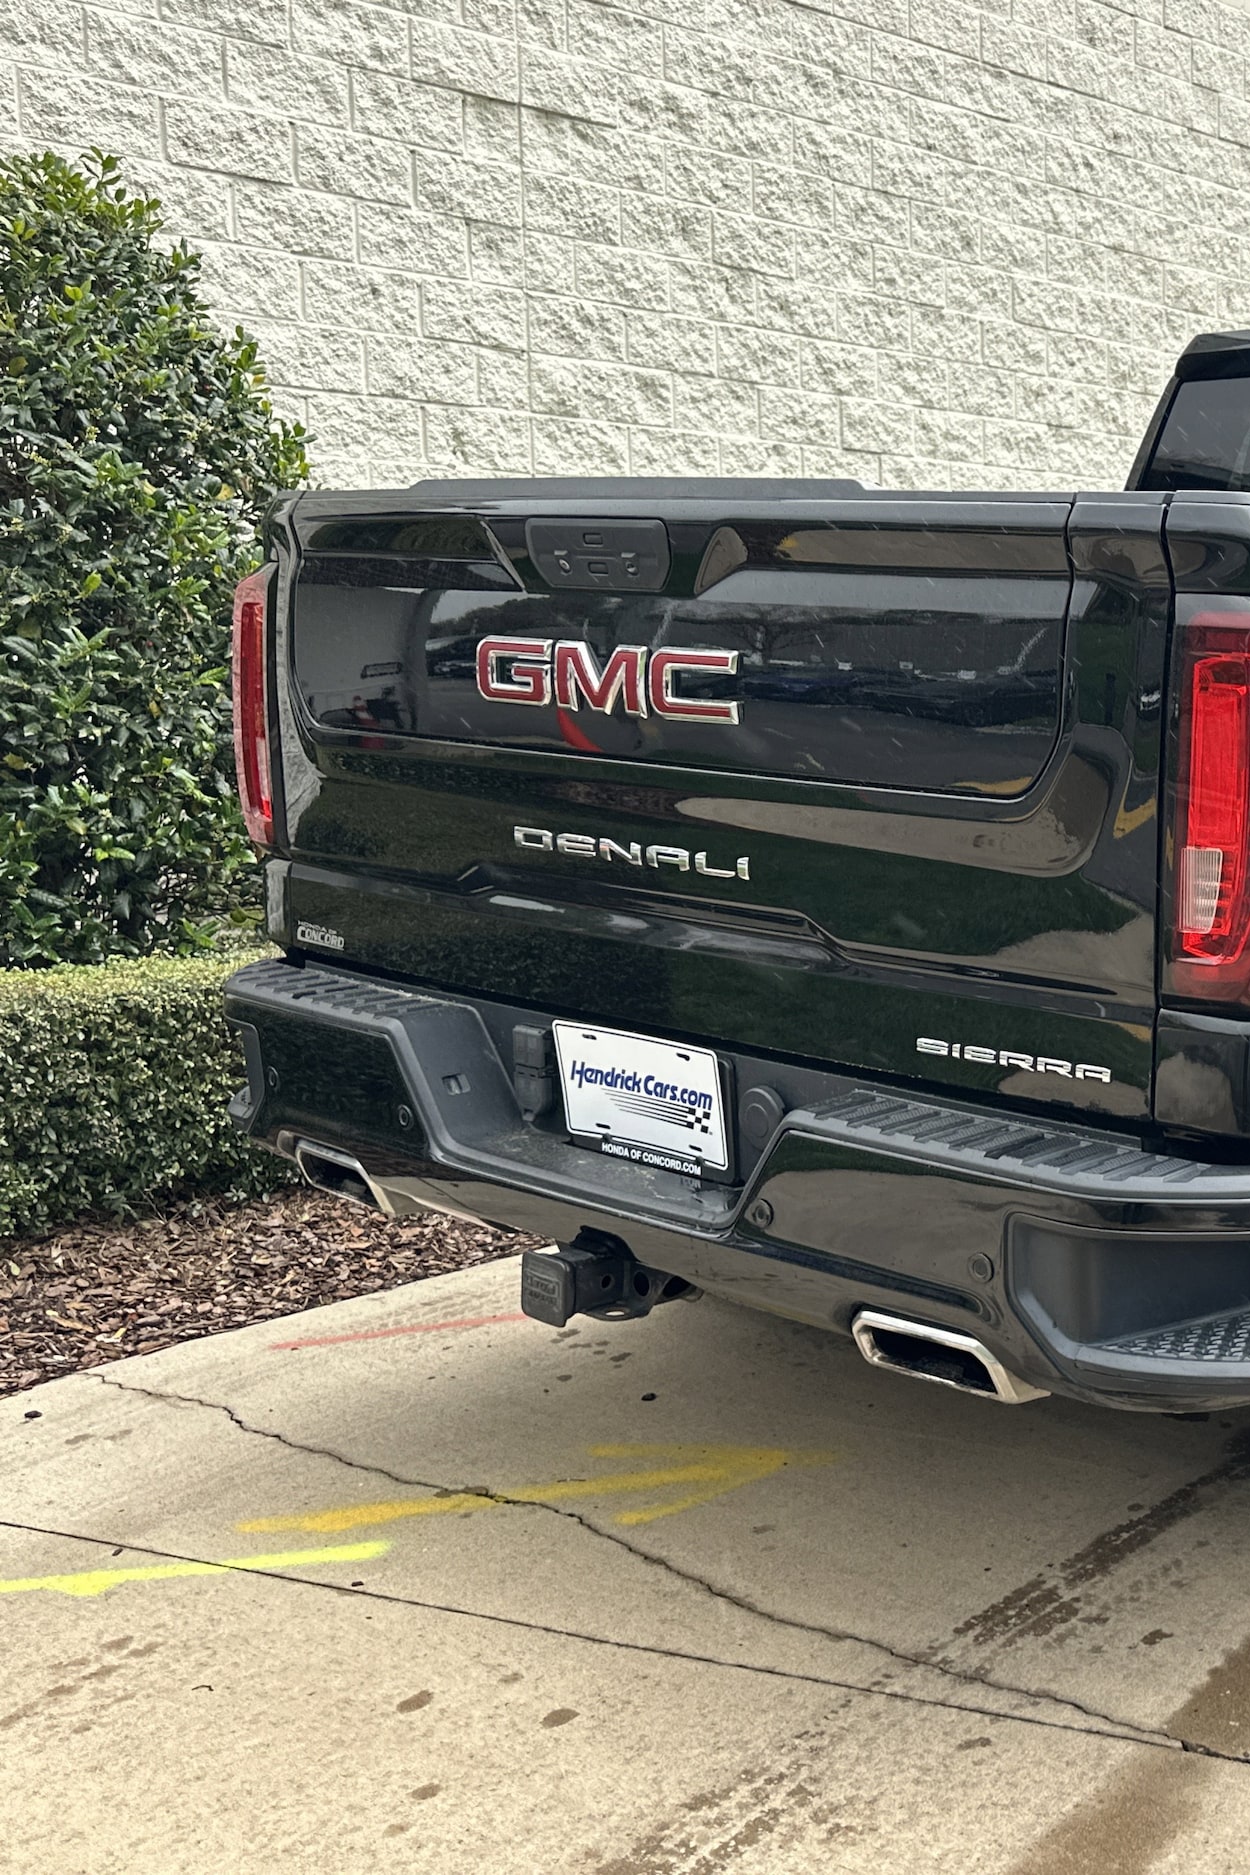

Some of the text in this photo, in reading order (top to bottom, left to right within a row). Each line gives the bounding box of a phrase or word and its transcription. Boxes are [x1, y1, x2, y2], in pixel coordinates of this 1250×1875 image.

[476, 635, 740, 725] GMC
[514, 826, 750, 880] DENALI
[297, 926, 345, 951] CONCORD
[916, 1037, 1112, 1083] SIERRA
[601, 1142, 701, 1176] HONDA OF CONCORD.COM
